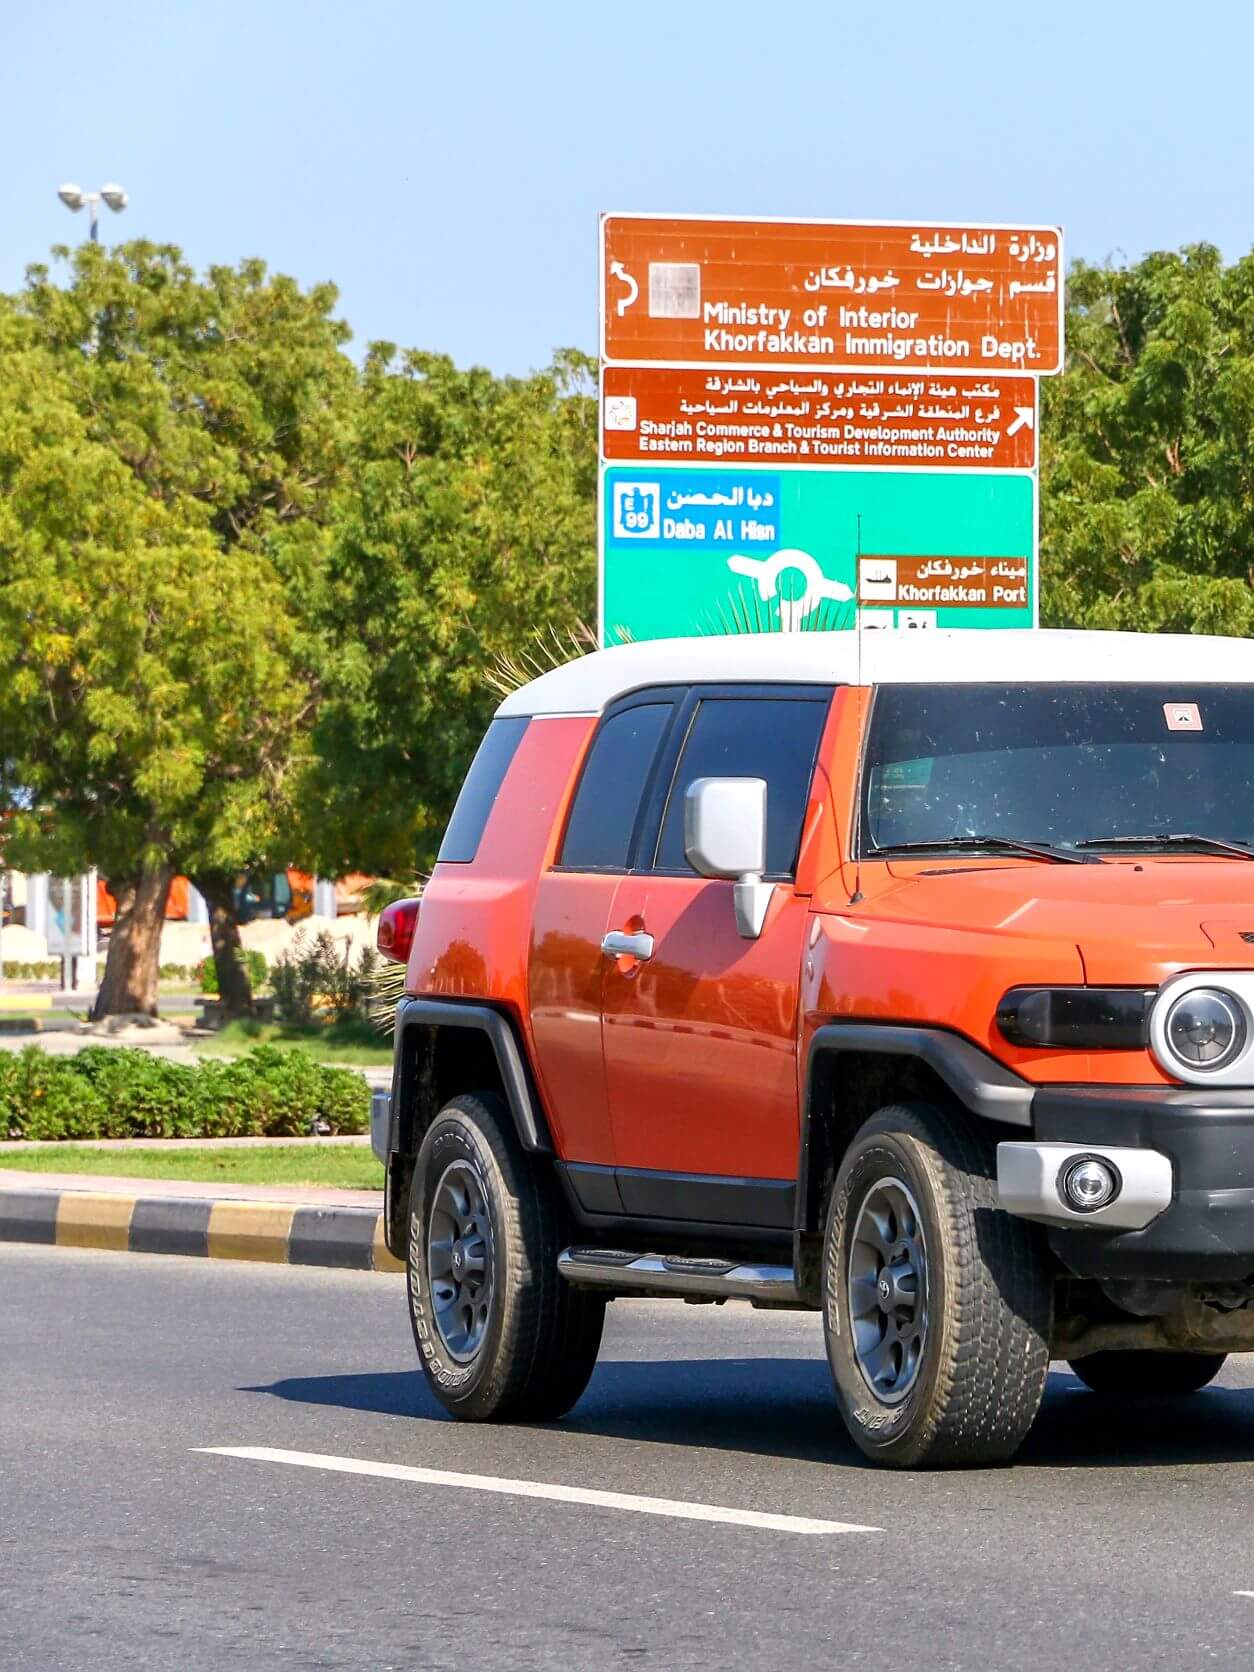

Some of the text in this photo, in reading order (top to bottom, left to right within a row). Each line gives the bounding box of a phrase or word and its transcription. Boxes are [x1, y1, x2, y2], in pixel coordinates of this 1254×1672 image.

[909, 232, 1056, 262] وزارة الداخلية
[804, 265, 1056, 299] قسم جوازات خورفكان
[703, 302, 918, 330] Ministry of Interior
[703, 328, 1041, 363] Khorfakkan Immigration Dept.
[705, 376, 761, 395] بالشارقة
[766, 378, 829, 399] والسياحي
[834, 380, 884, 398] التجاري
[928, 383, 957, 399] هيئة
[961, 383, 1001, 399] مكتب
[679, 399, 1001, 424] فرع المنطقة الشرقية ومركز المعلومات السياحية
[639, 420, 1001, 445] Sharjah Commerce & Tourism Development Authority
[639, 436, 994, 459] Eastern Region Branch & Tourist Information Center
[666, 485, 775, 511] دبا الحصن
[625, 511, 649, 528] 99
[663, 518, 775, 541] Daba Al Hisn
[915, 558, 1026, 580] ميناء خورفكان
[898, 584, 1027, 602] Khorfakkan Port
